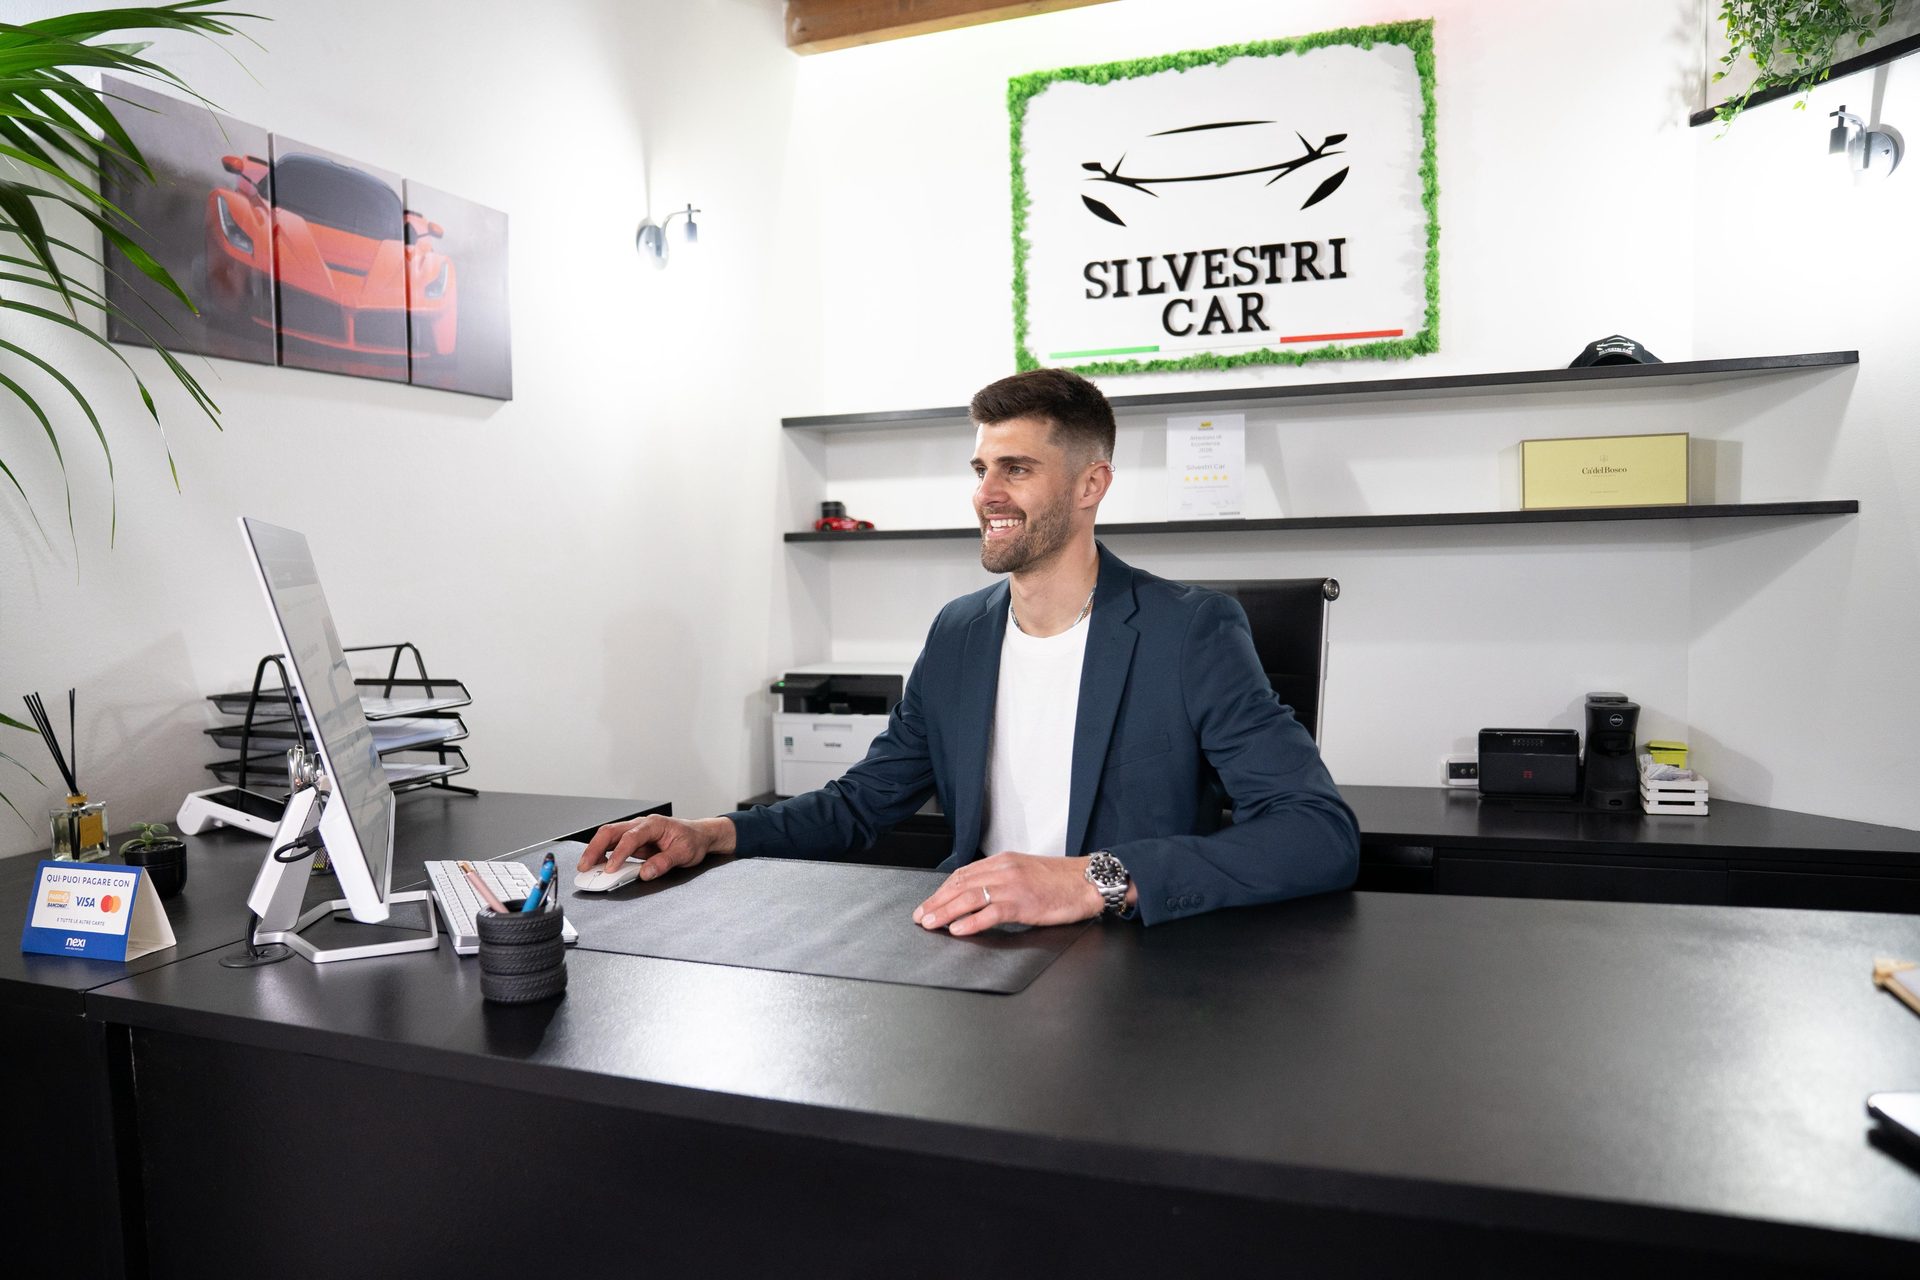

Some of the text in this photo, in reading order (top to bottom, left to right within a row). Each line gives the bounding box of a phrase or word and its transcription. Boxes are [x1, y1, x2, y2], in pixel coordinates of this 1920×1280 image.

[1083, 238, 1347, 299] SILVESTRI
[1162, 292, 1270, 337] CAR
[46, 874, 130, 888] QUI PUOI PAGARE CON
[76, 896, 96, 907] VISA
[65, 937, 86, 947] nexi
